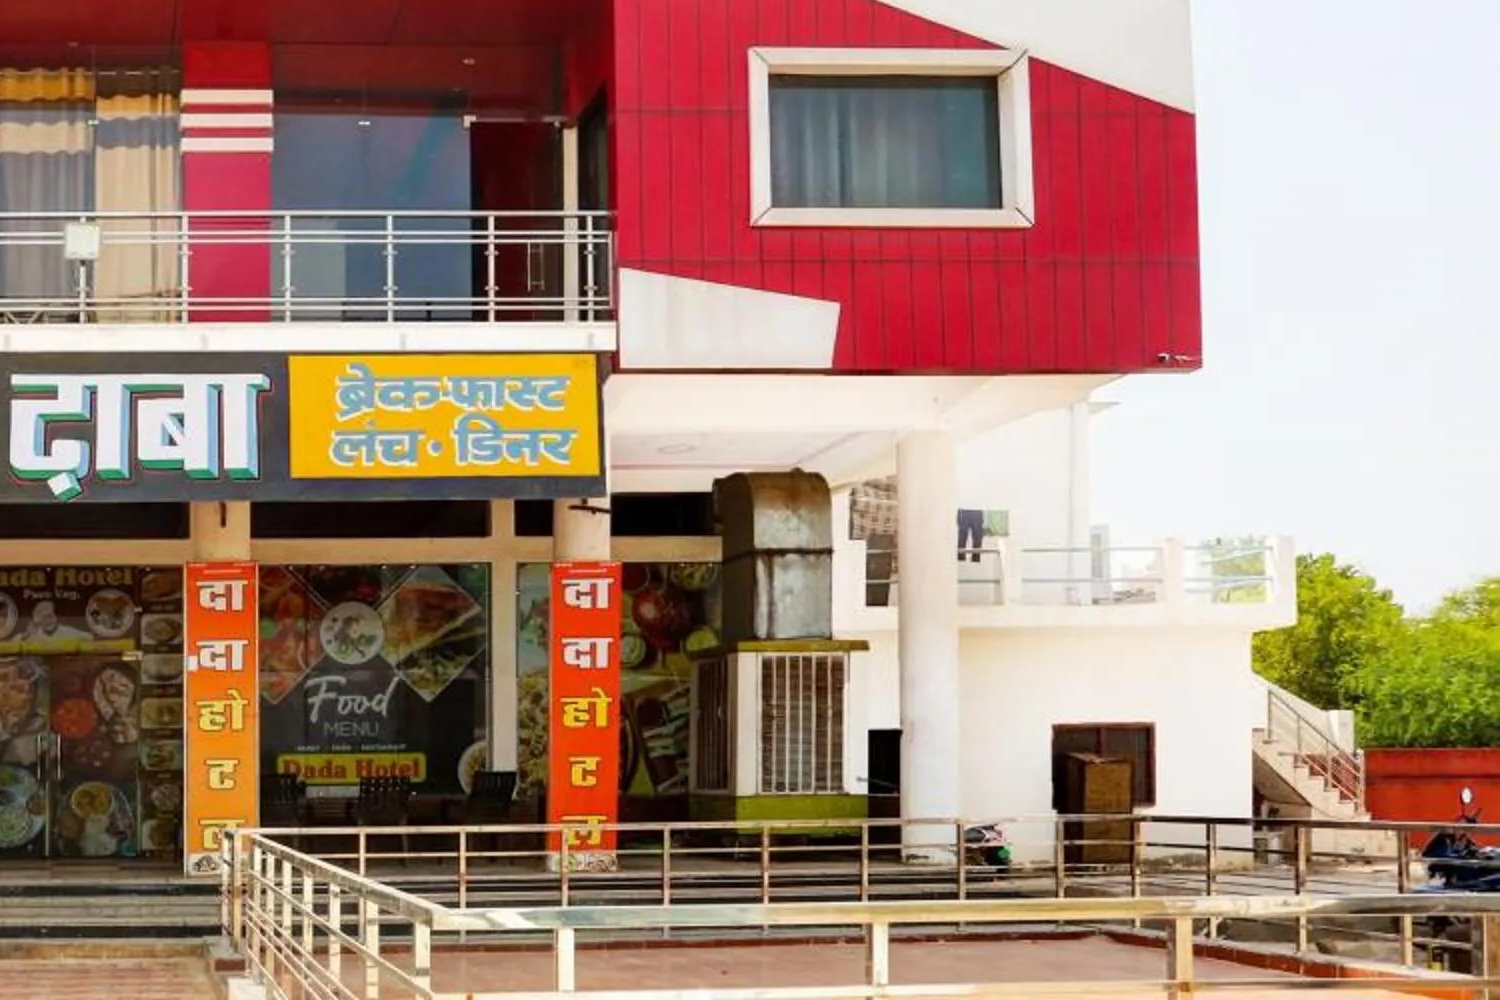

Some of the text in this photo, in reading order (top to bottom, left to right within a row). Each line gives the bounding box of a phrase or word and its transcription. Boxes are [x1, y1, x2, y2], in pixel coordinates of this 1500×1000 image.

[329, 410, 580, 467] लंच डिनर
[304, 675, 400, 723] Food
[323, 721, 380, 737] MENU
